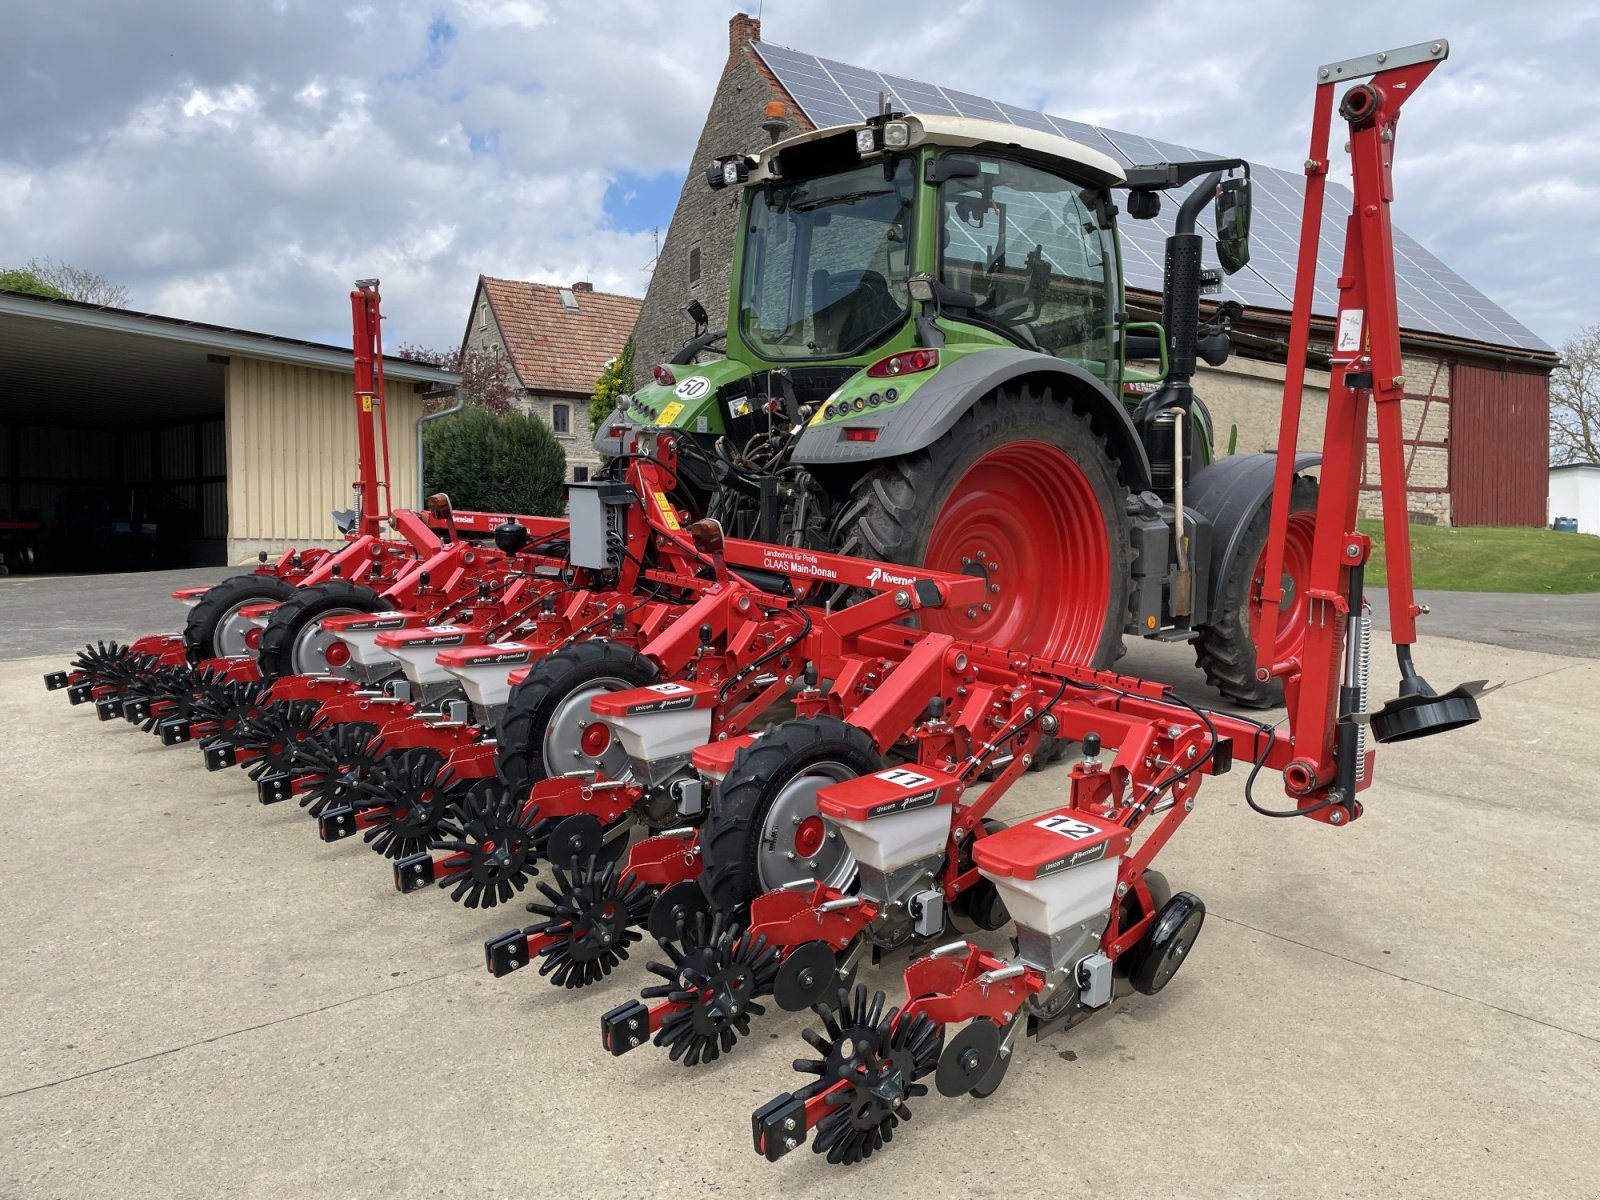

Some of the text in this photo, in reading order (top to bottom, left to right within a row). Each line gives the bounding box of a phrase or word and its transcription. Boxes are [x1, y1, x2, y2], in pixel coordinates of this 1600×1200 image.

[678, 378, 705, 396] 50
[764, 550, 794, 560] Landtechnik
[802, 554, 818, 564] Profis
[764, 558, 837, 579] CLAAS Main-Donau
[882, 571, 917, 586] Kverne
[887, 771, 927, 786] 11
[876, 803, 896, 812] Unicorn
[1045, 818, 1095, 839] 12
[1045, 859, 1065, 870] Unicorn
